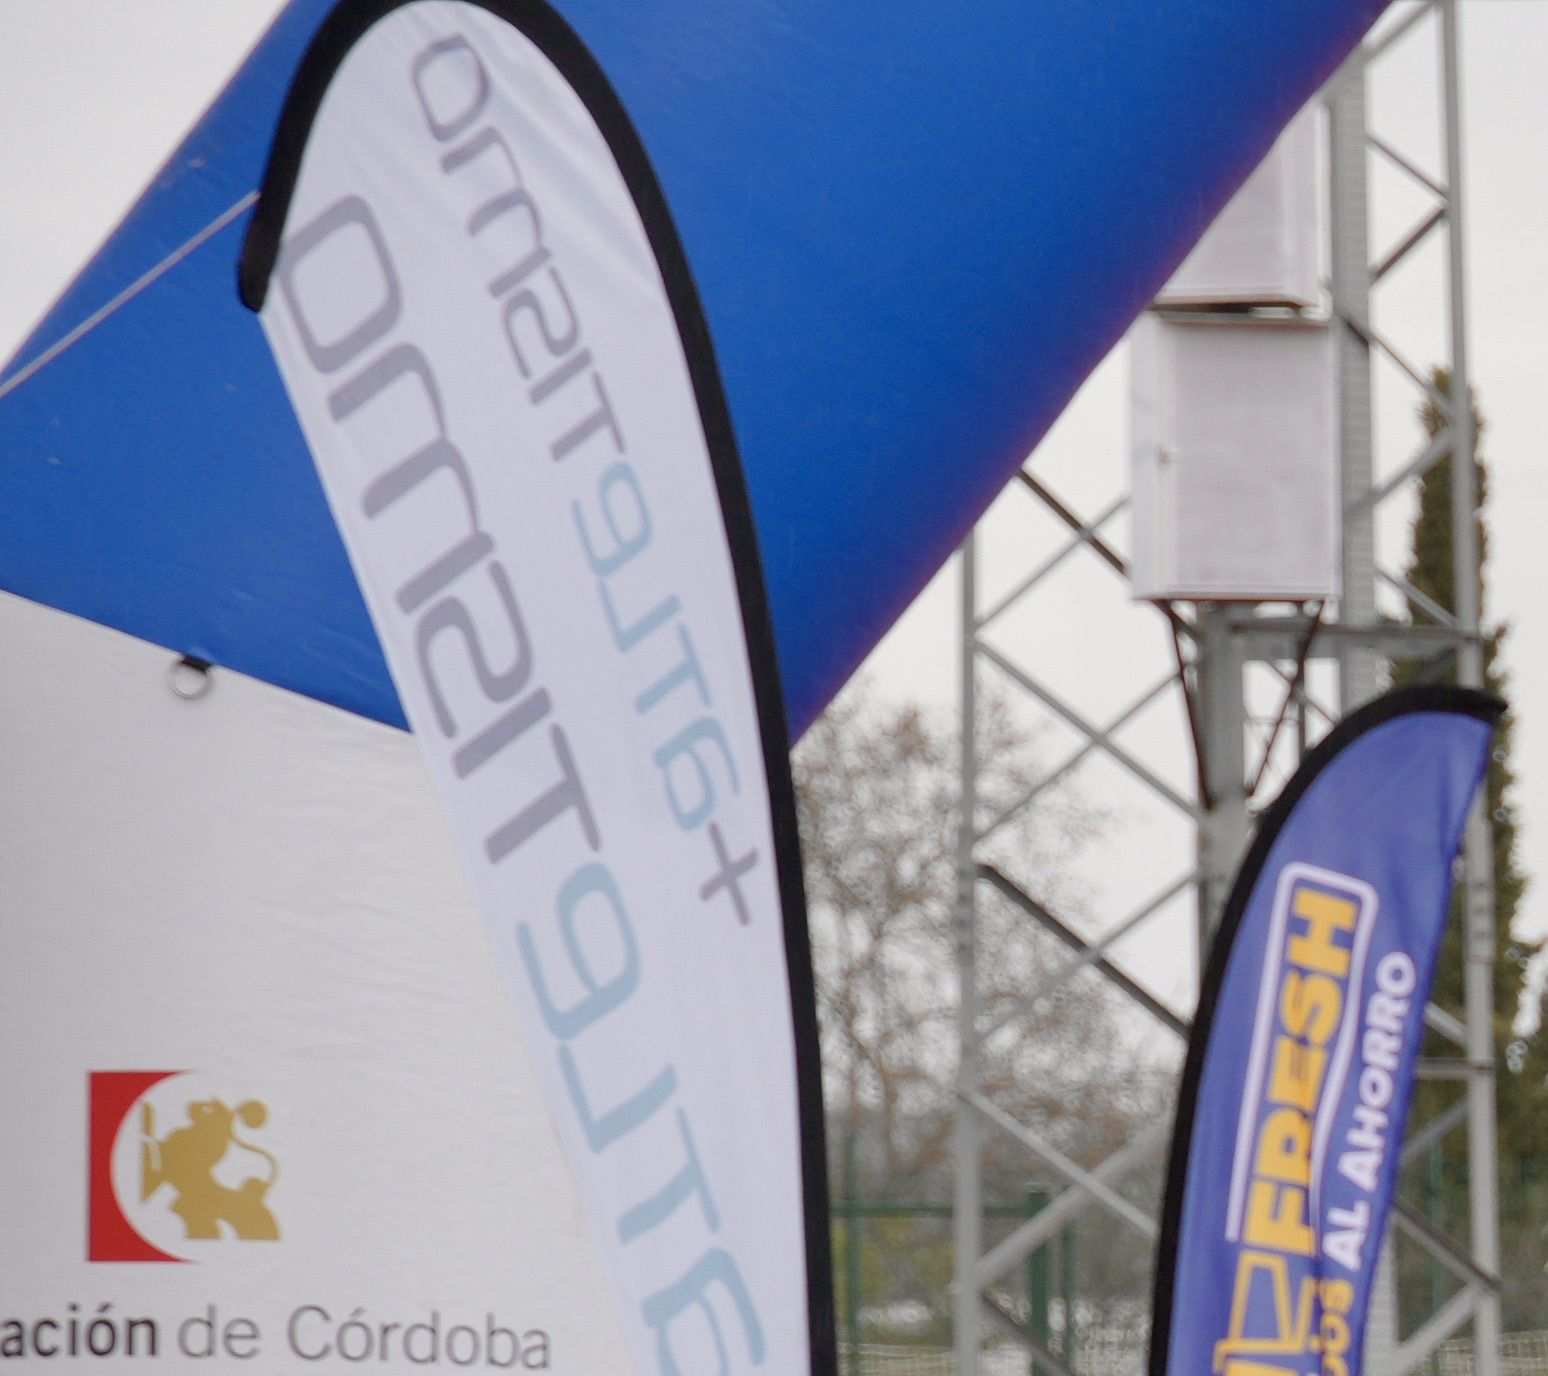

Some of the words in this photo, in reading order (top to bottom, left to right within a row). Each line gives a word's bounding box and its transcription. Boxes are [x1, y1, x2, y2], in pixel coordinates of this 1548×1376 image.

[1244, 889, 1358, 1256] FRESH
[1338, 950, 1417, 1191] AHORRO
[1321, 1203, 1370, 1270] AL
[179, 1304, 262, 1358] de
[288, 1305, 552, 1370] Córdoba
